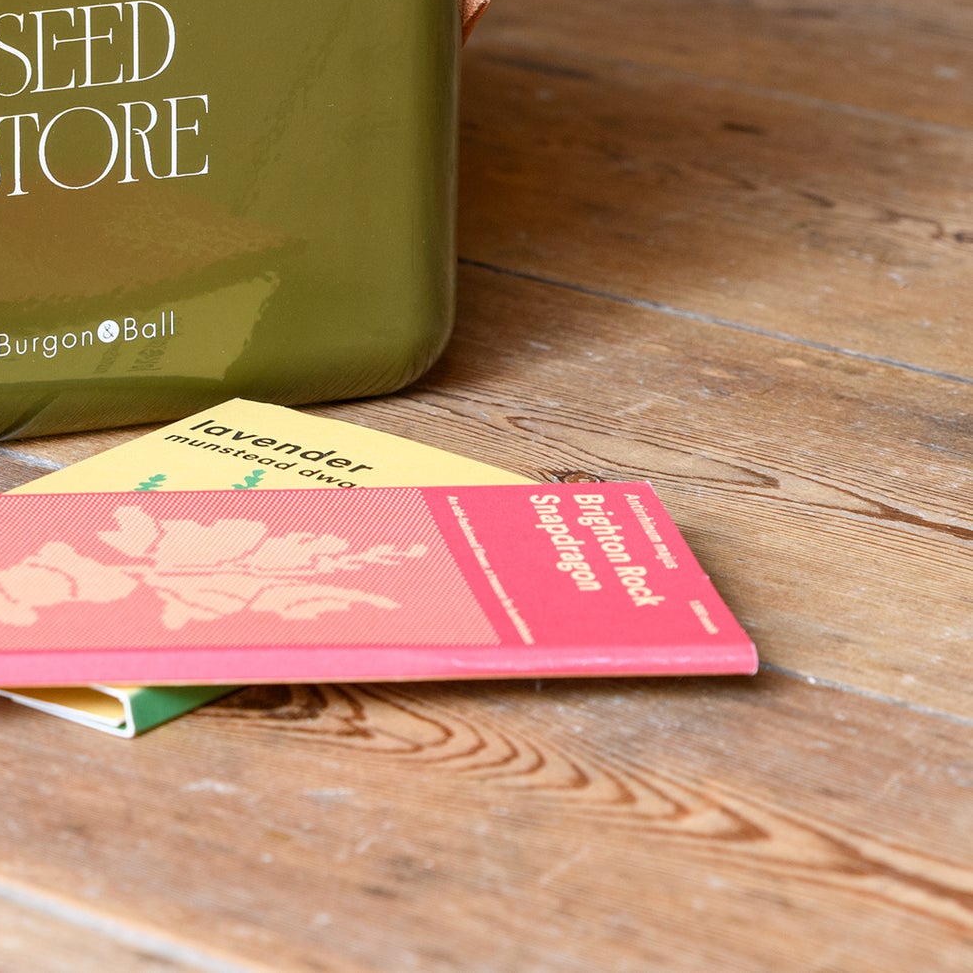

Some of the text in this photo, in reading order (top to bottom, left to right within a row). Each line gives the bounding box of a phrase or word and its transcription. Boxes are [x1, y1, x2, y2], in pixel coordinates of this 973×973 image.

[164, 434, 365, 489] munstead dwa
[189, 419, 374, 473] lavender
[529, 493, 603, 592] Snapdragon
[573, 493, 666, 607] Brighton Rock
